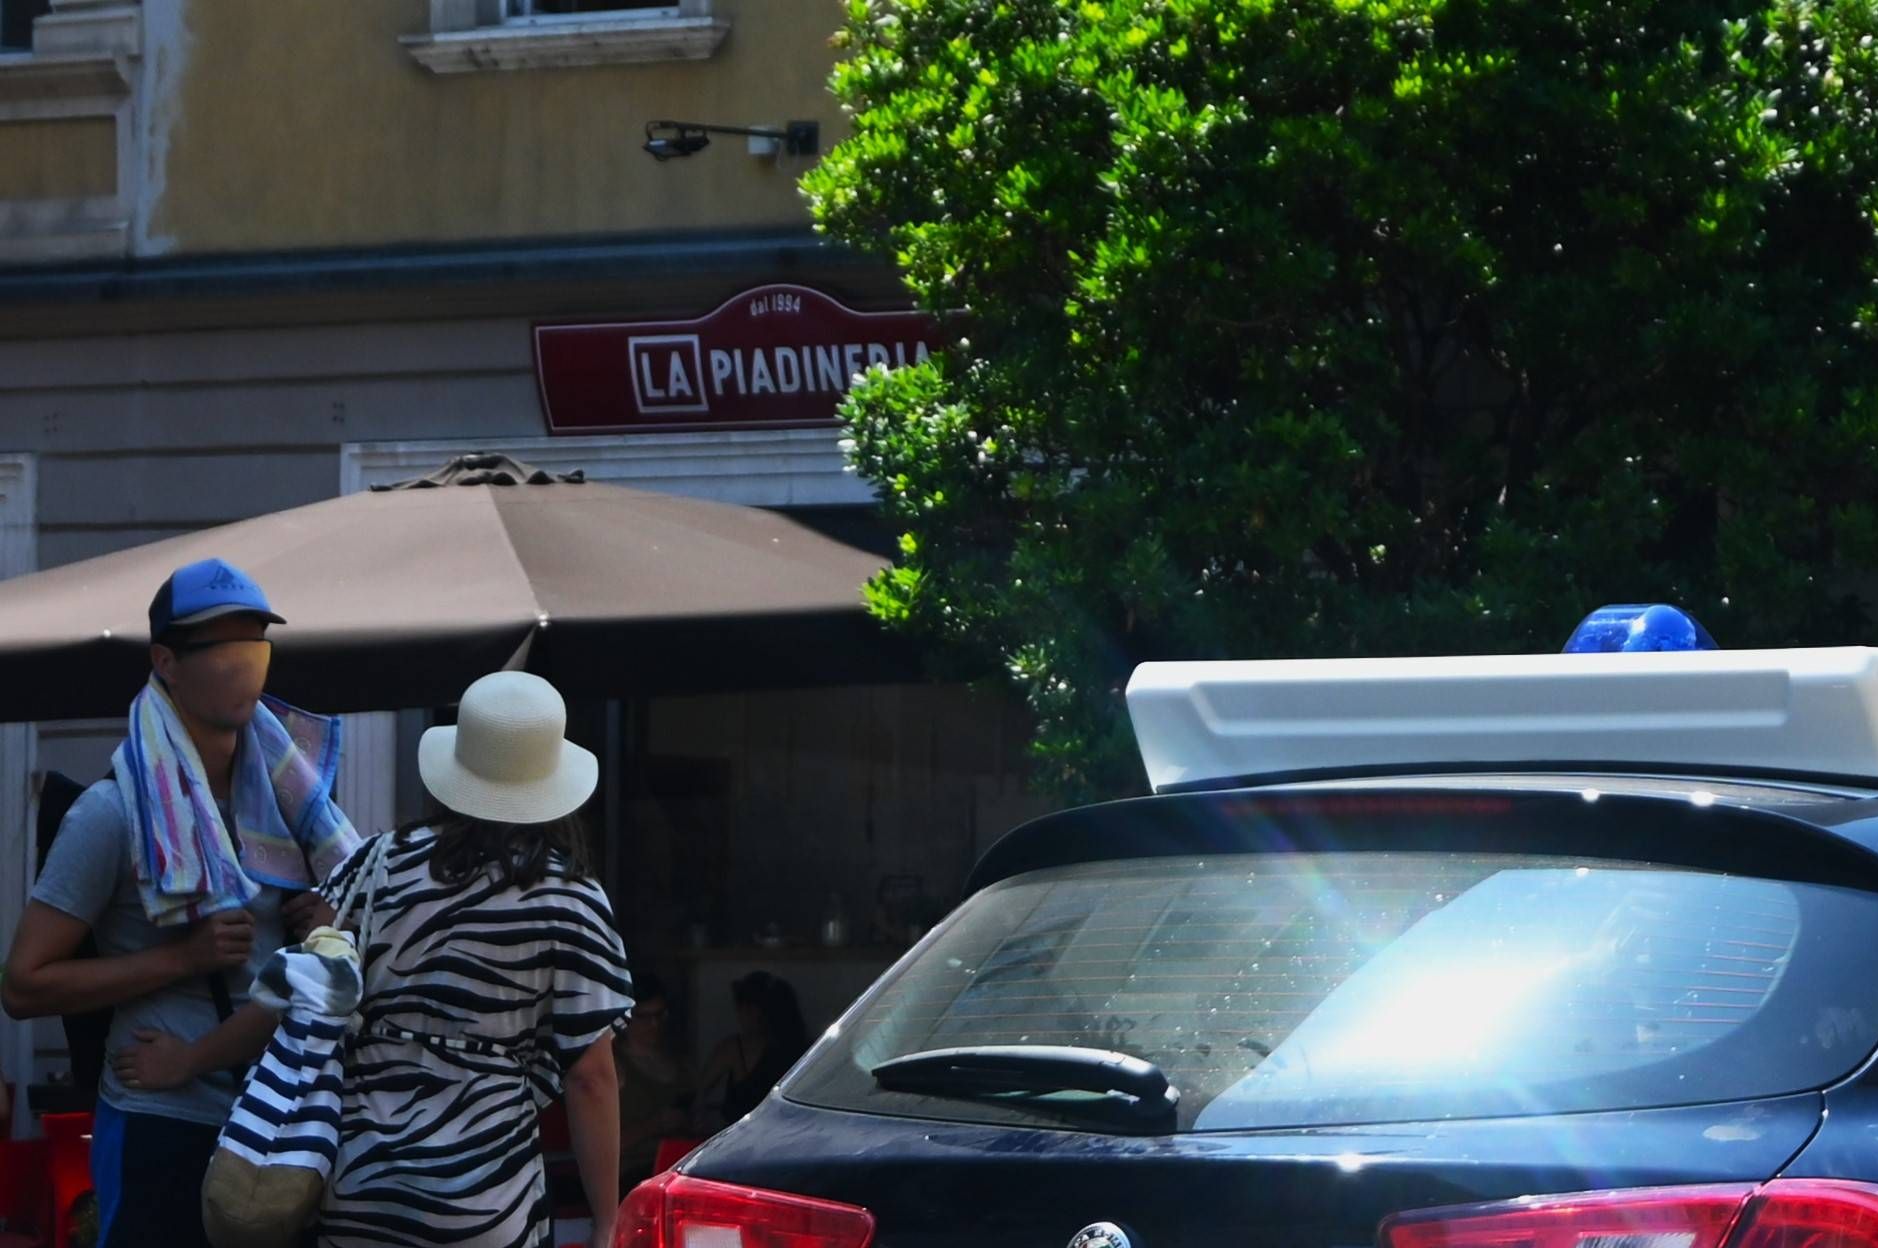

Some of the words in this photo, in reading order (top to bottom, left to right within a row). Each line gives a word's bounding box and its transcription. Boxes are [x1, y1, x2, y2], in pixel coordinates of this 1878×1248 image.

[751, 295, 769, 316] dal
[772, 293, 801, 313] 1994
[641, 351, 693, 397] LA
